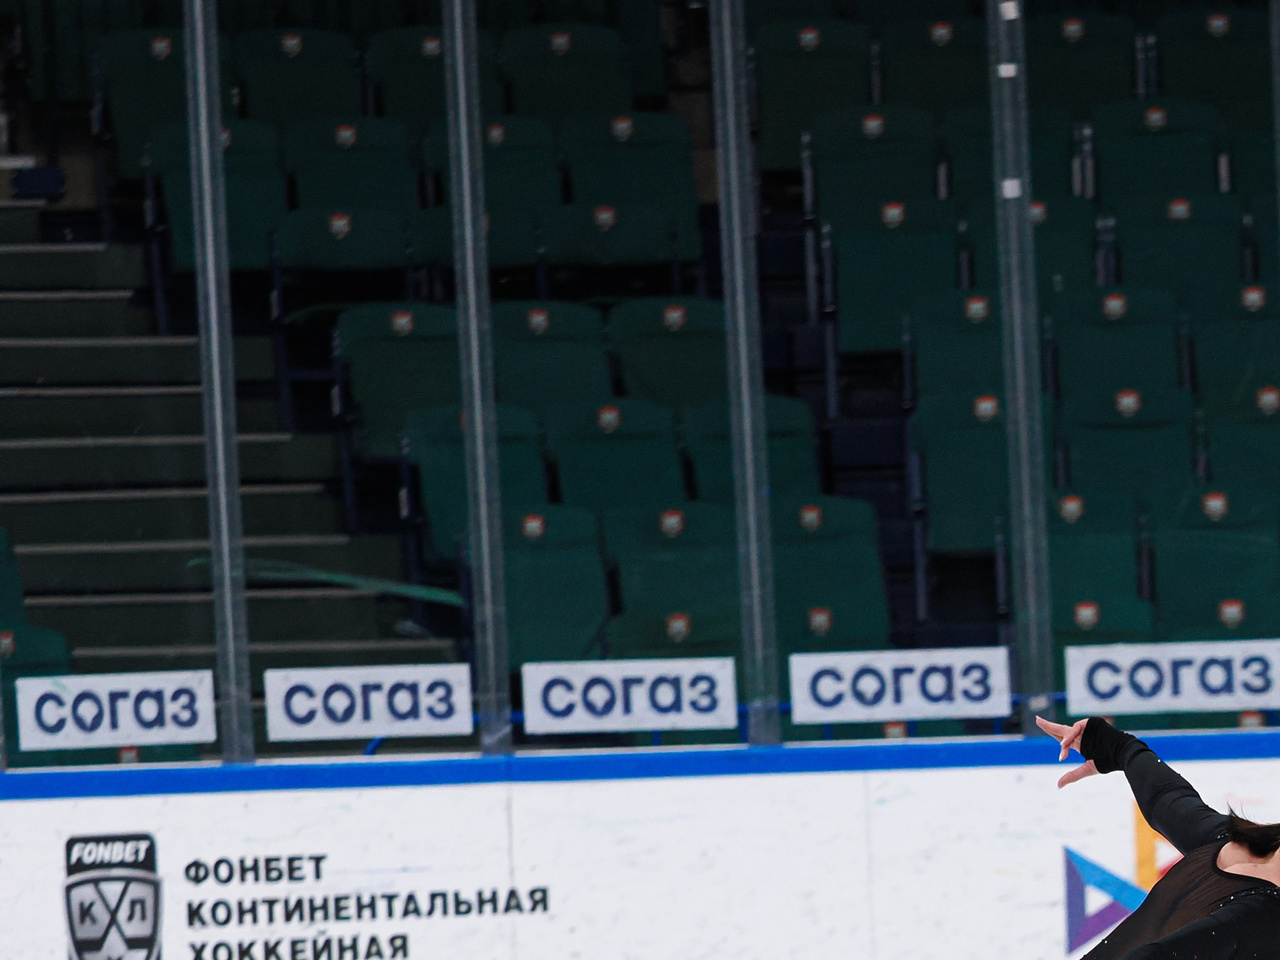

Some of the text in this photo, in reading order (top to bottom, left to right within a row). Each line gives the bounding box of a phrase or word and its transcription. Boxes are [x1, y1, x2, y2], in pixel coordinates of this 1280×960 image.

[70, 840, 150, 866] FONBET
[184, 855, 327, 885] ФОНБЕТ
[186, 887, 549, 928] КОНТИНЕНТАЛЬНАЯ
